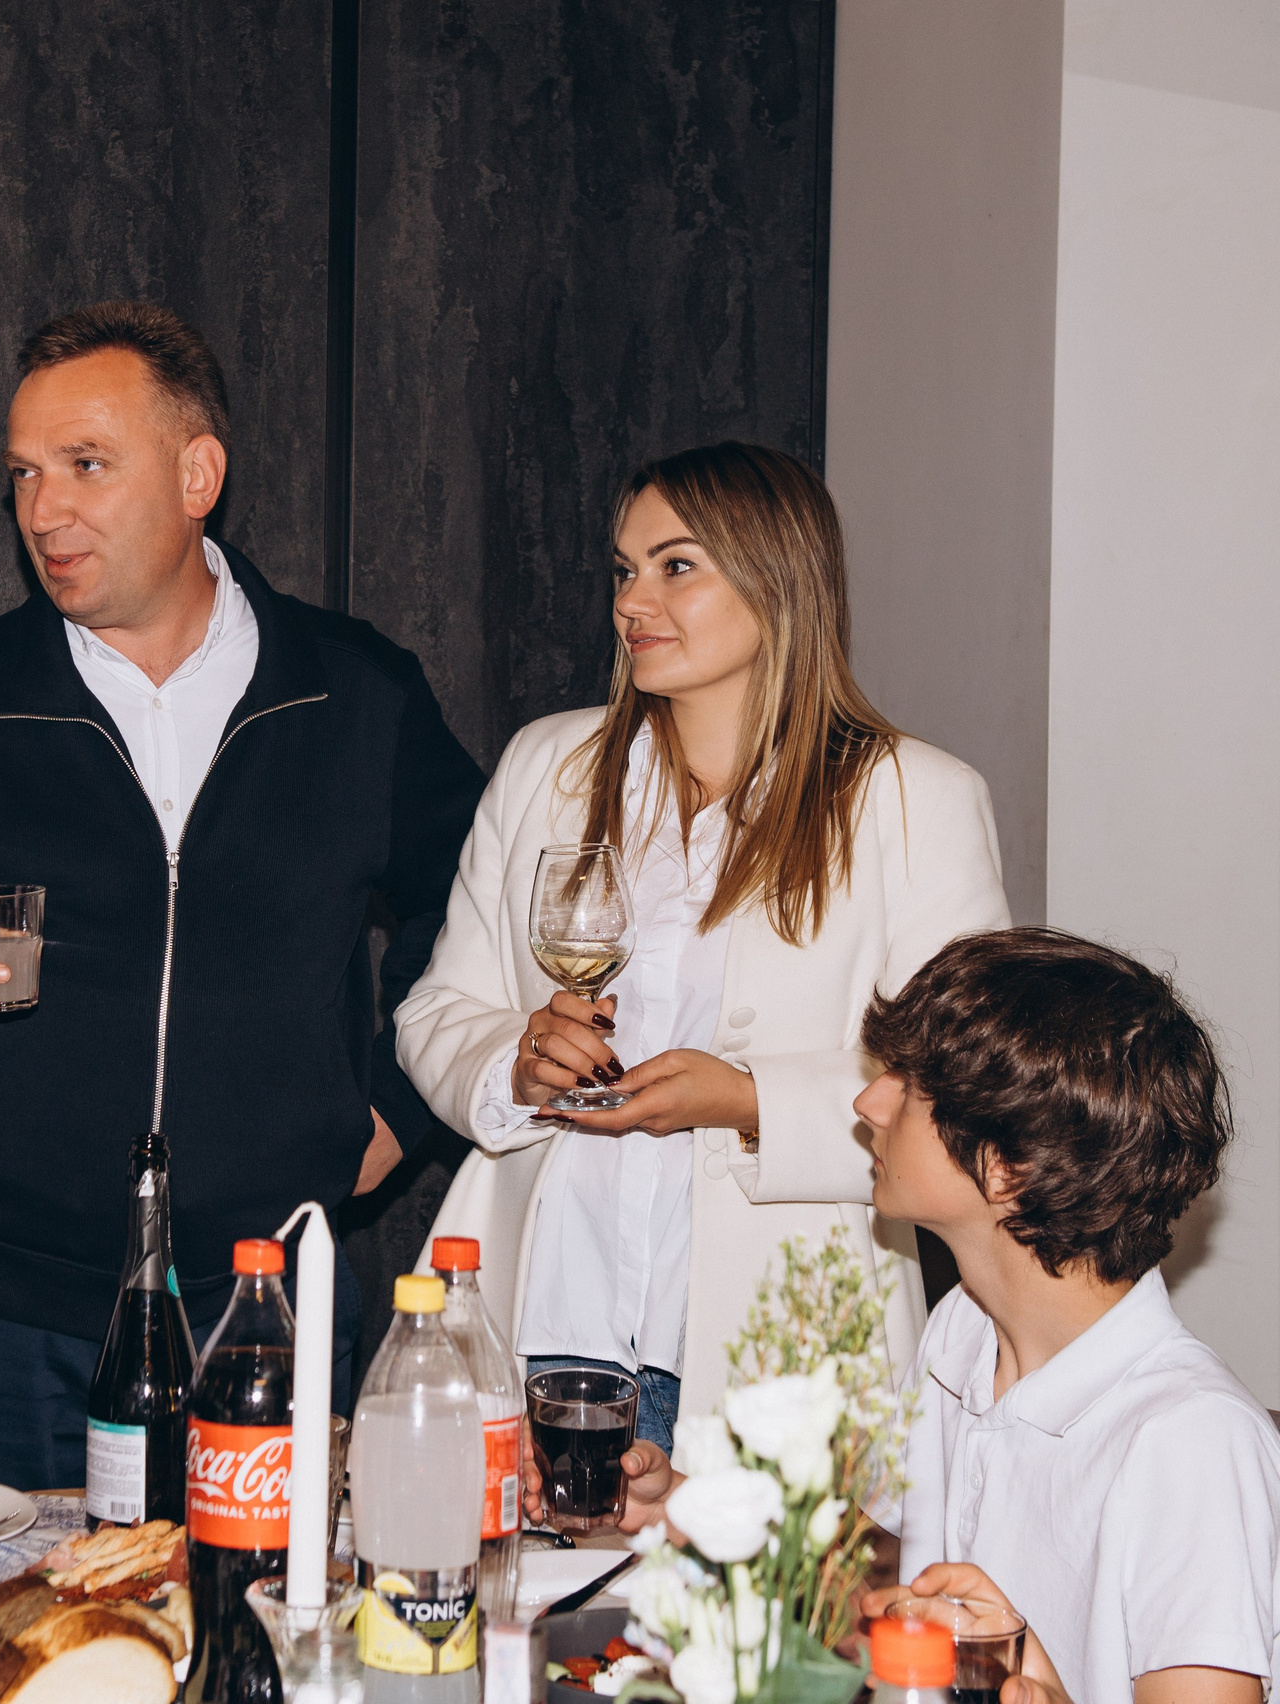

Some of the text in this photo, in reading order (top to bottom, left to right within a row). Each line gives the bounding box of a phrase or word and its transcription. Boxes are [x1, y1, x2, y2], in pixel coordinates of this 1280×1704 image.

[187, 1428, 292, 1503] Coca-Co
[191, 1497, 290, 1521] ORIGINAL TAST
[401, 1599, 466, 1622] TONIC
